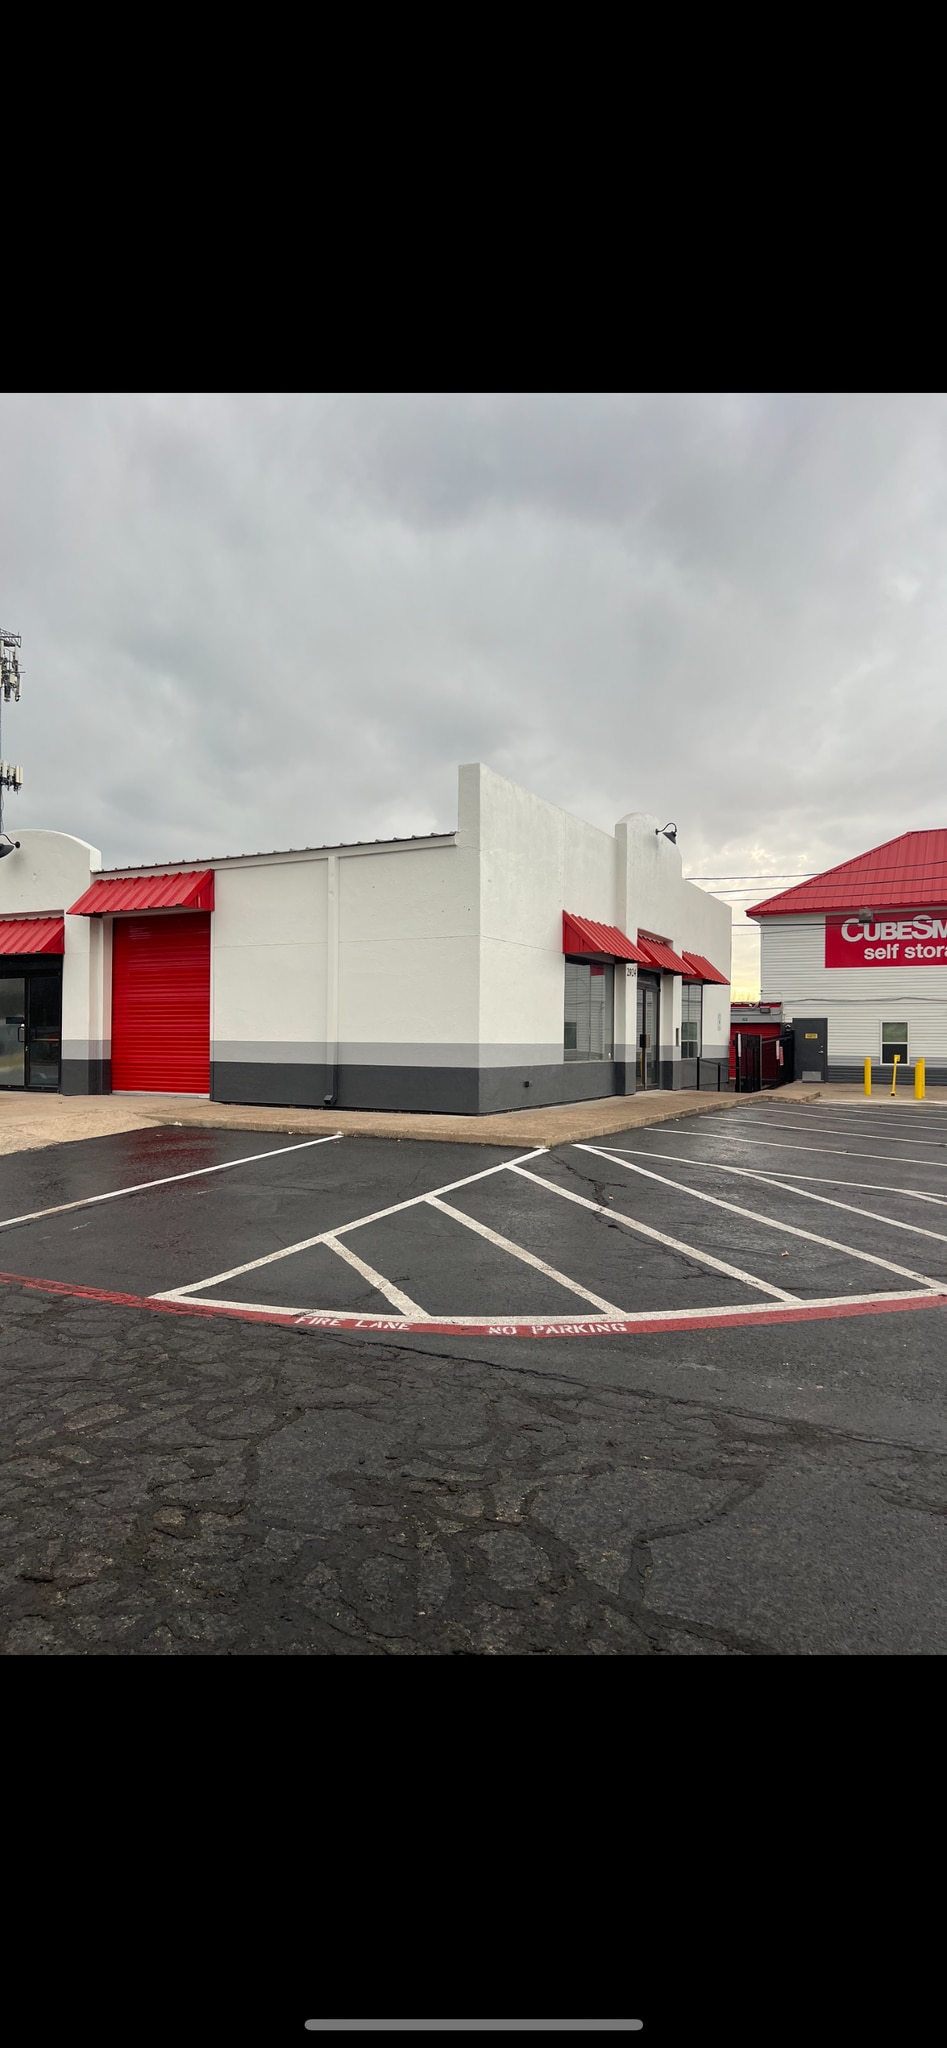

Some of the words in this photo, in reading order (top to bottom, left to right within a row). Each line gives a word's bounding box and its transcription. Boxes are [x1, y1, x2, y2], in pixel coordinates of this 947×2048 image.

[863, 943, 899, 960] self
[904, 943, 947, 959] stor
[294, 1316, 345, 1326] FIRE
[355, 1320, 414, 1330] LANE
[488, 1326, 517, 1335] NO
[531, 1323, 628, 1335] PARKING
